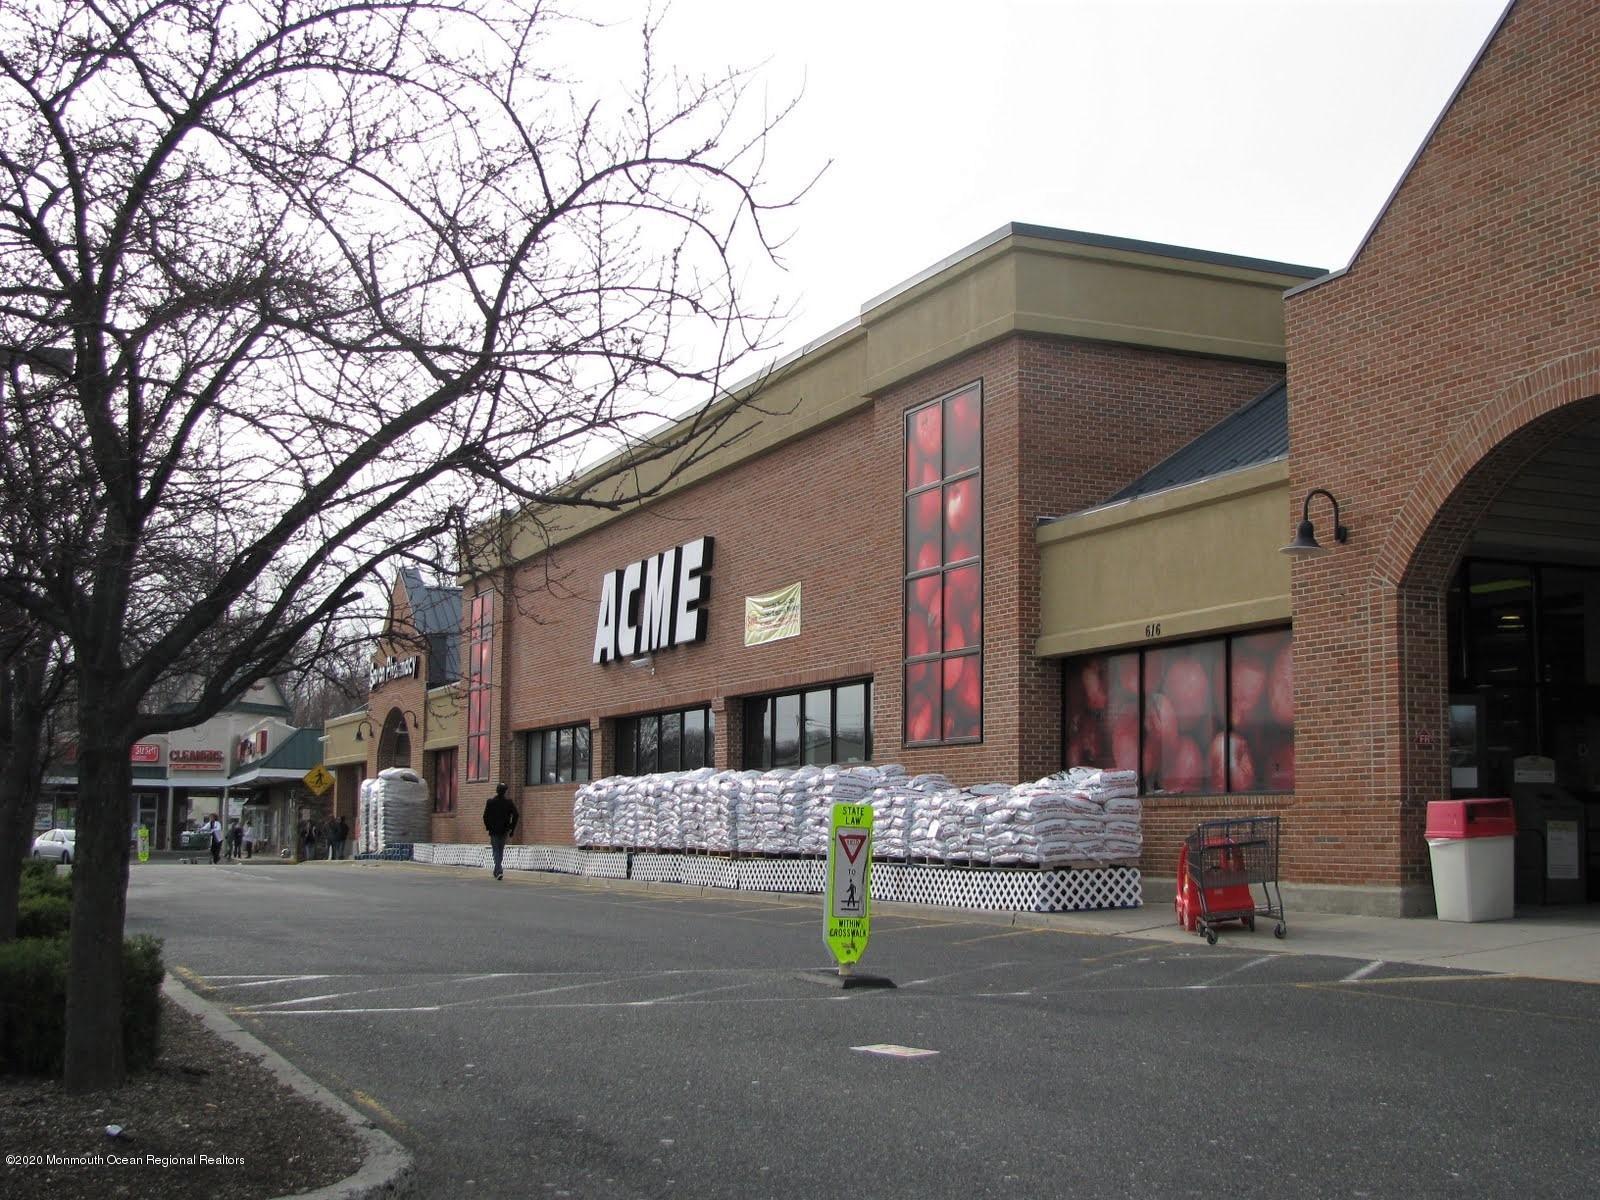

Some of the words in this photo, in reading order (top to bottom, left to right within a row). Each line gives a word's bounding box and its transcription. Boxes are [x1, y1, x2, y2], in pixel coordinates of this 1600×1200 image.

[593, 536, 711, 664] ACME
[1145, 622, 1161, 637] 616
[842, 806, 865, 816] STATE
[845, 816, 862, 825] LAW
[838, 919, 861, 928] WITHIN
[829, 928, 867, 937] CROSSWALK
